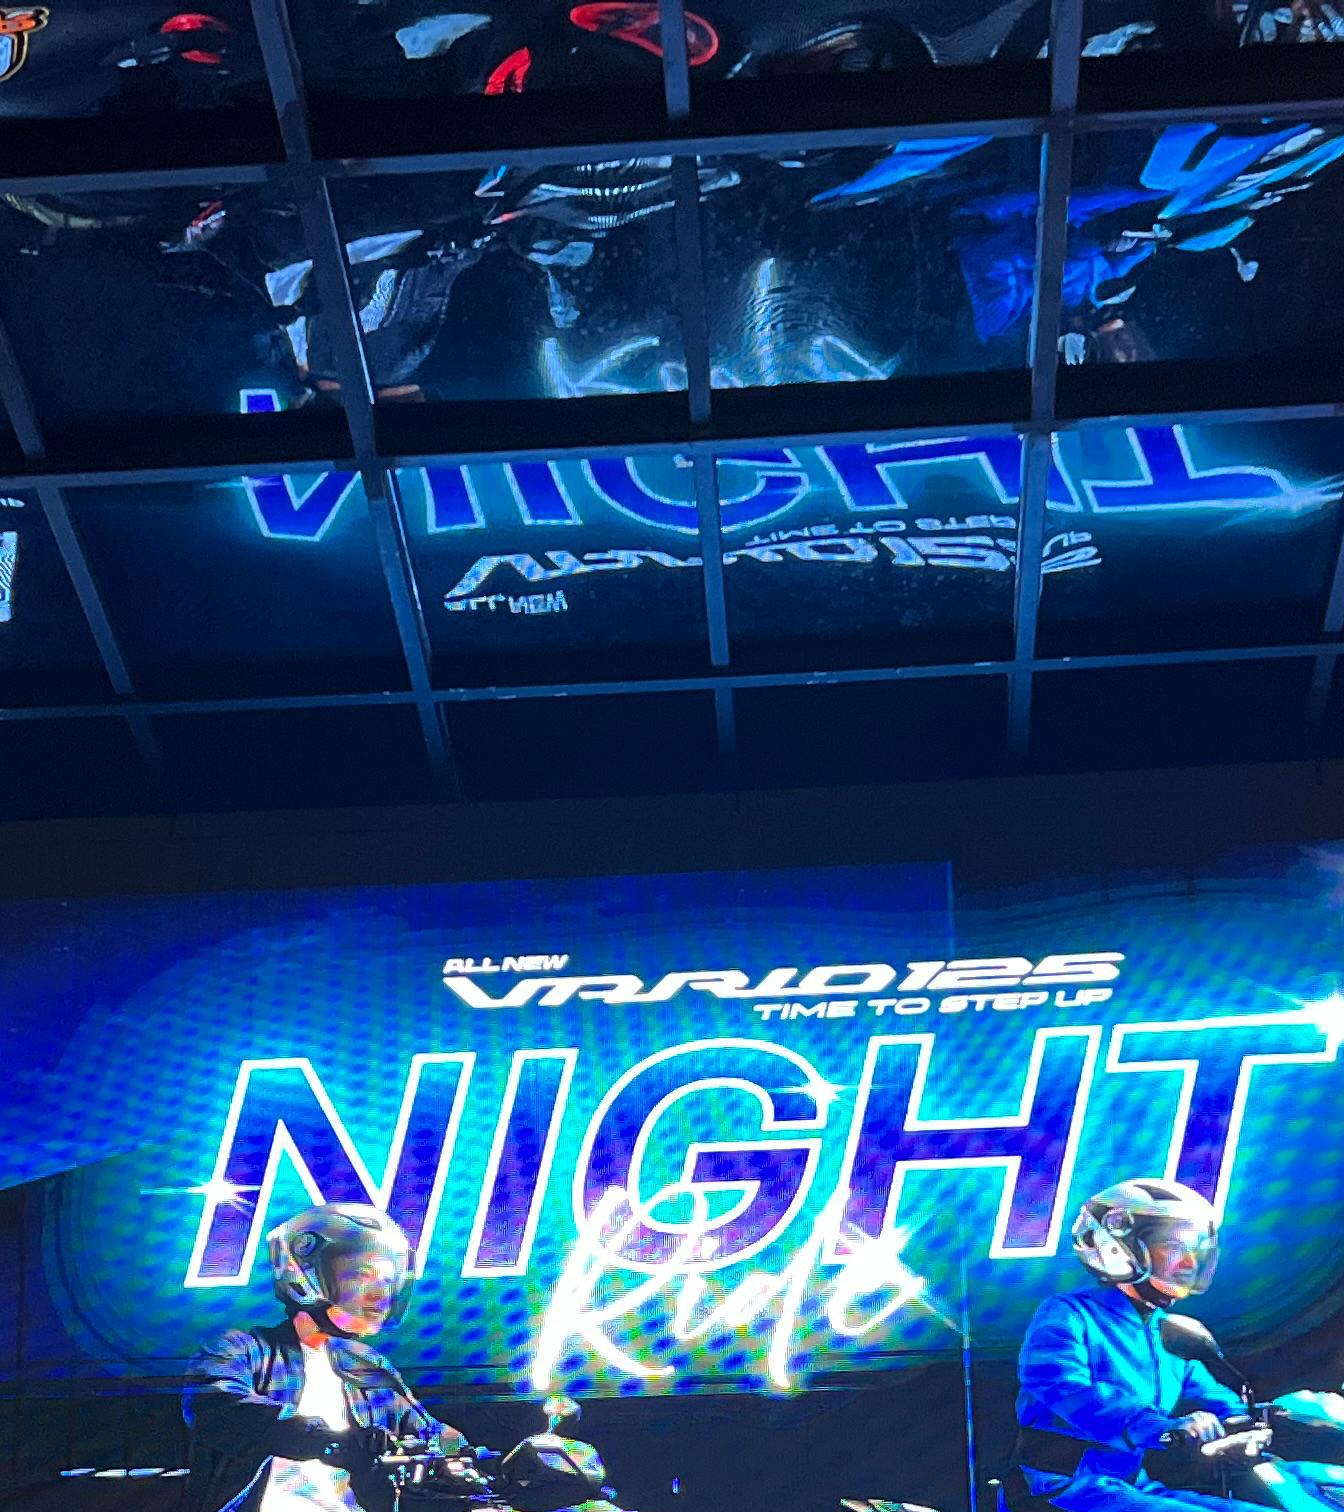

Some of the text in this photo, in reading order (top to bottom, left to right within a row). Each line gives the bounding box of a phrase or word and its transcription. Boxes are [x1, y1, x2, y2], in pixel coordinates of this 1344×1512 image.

[443, 954, 569, 974] ALL NEW
[754, 988, 1113, 1020] TIME TO STEP UP
[530, 1184, 928, 1391] Ride
